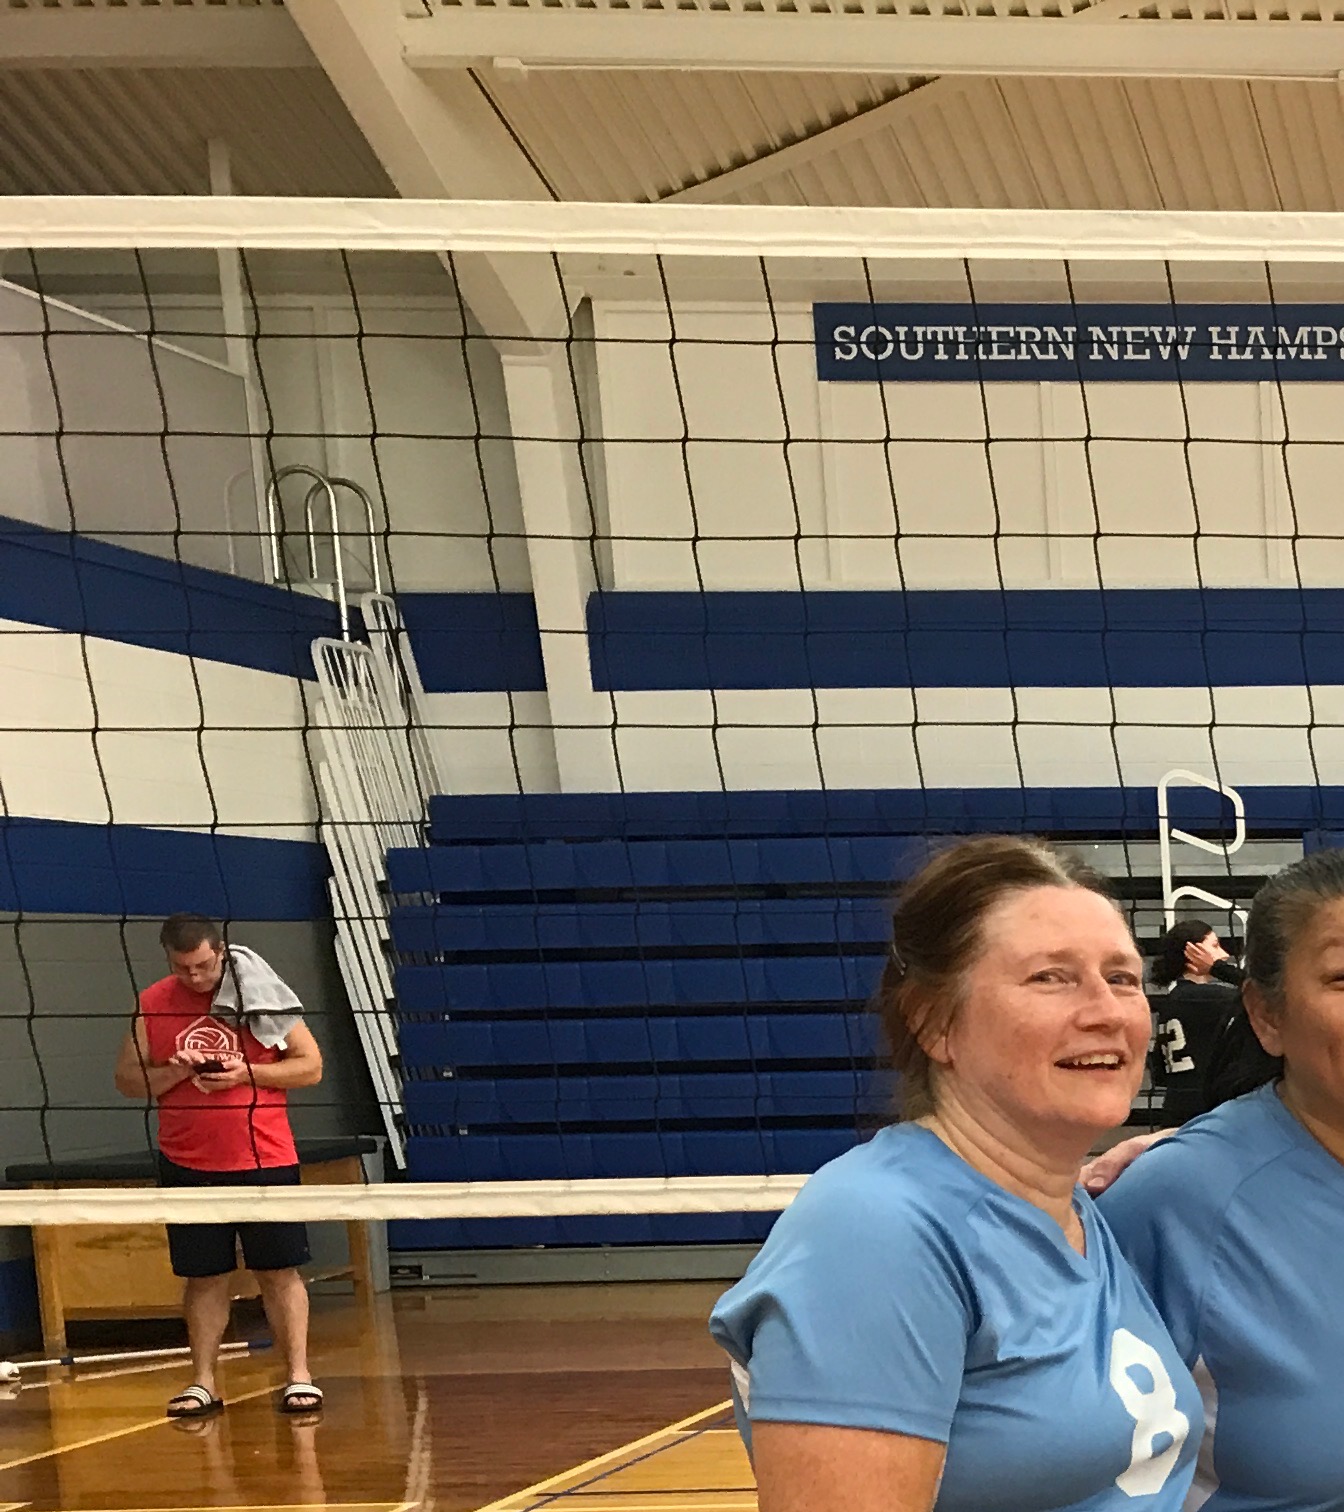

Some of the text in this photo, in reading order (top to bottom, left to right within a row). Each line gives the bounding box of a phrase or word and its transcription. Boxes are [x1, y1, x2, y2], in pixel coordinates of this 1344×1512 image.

[834, 326, 1076, 360] SOUTHERN
[1088, 326, 1196, 360] NEW
[1109, 1328, 1190, 1498] 8
